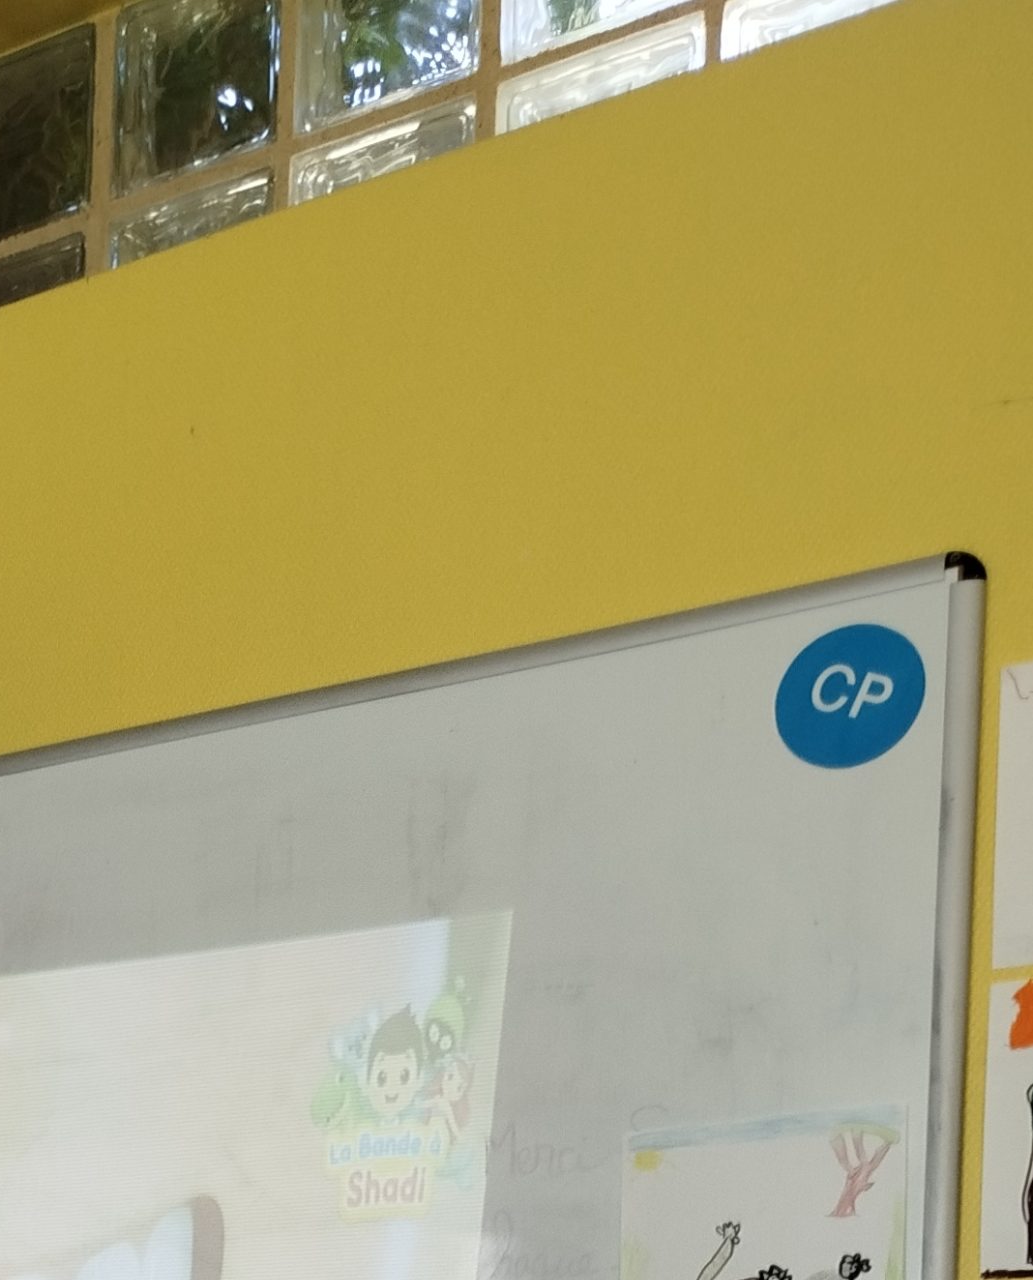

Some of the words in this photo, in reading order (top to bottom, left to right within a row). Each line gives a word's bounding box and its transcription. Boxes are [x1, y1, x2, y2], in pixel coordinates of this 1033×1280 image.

[811, 664, 894, 718] CP
[330, 1144, 351, 1164] La
[358, 1132, 422, 1158] Bande
[346, 1166, 426, 1208] Shadi
